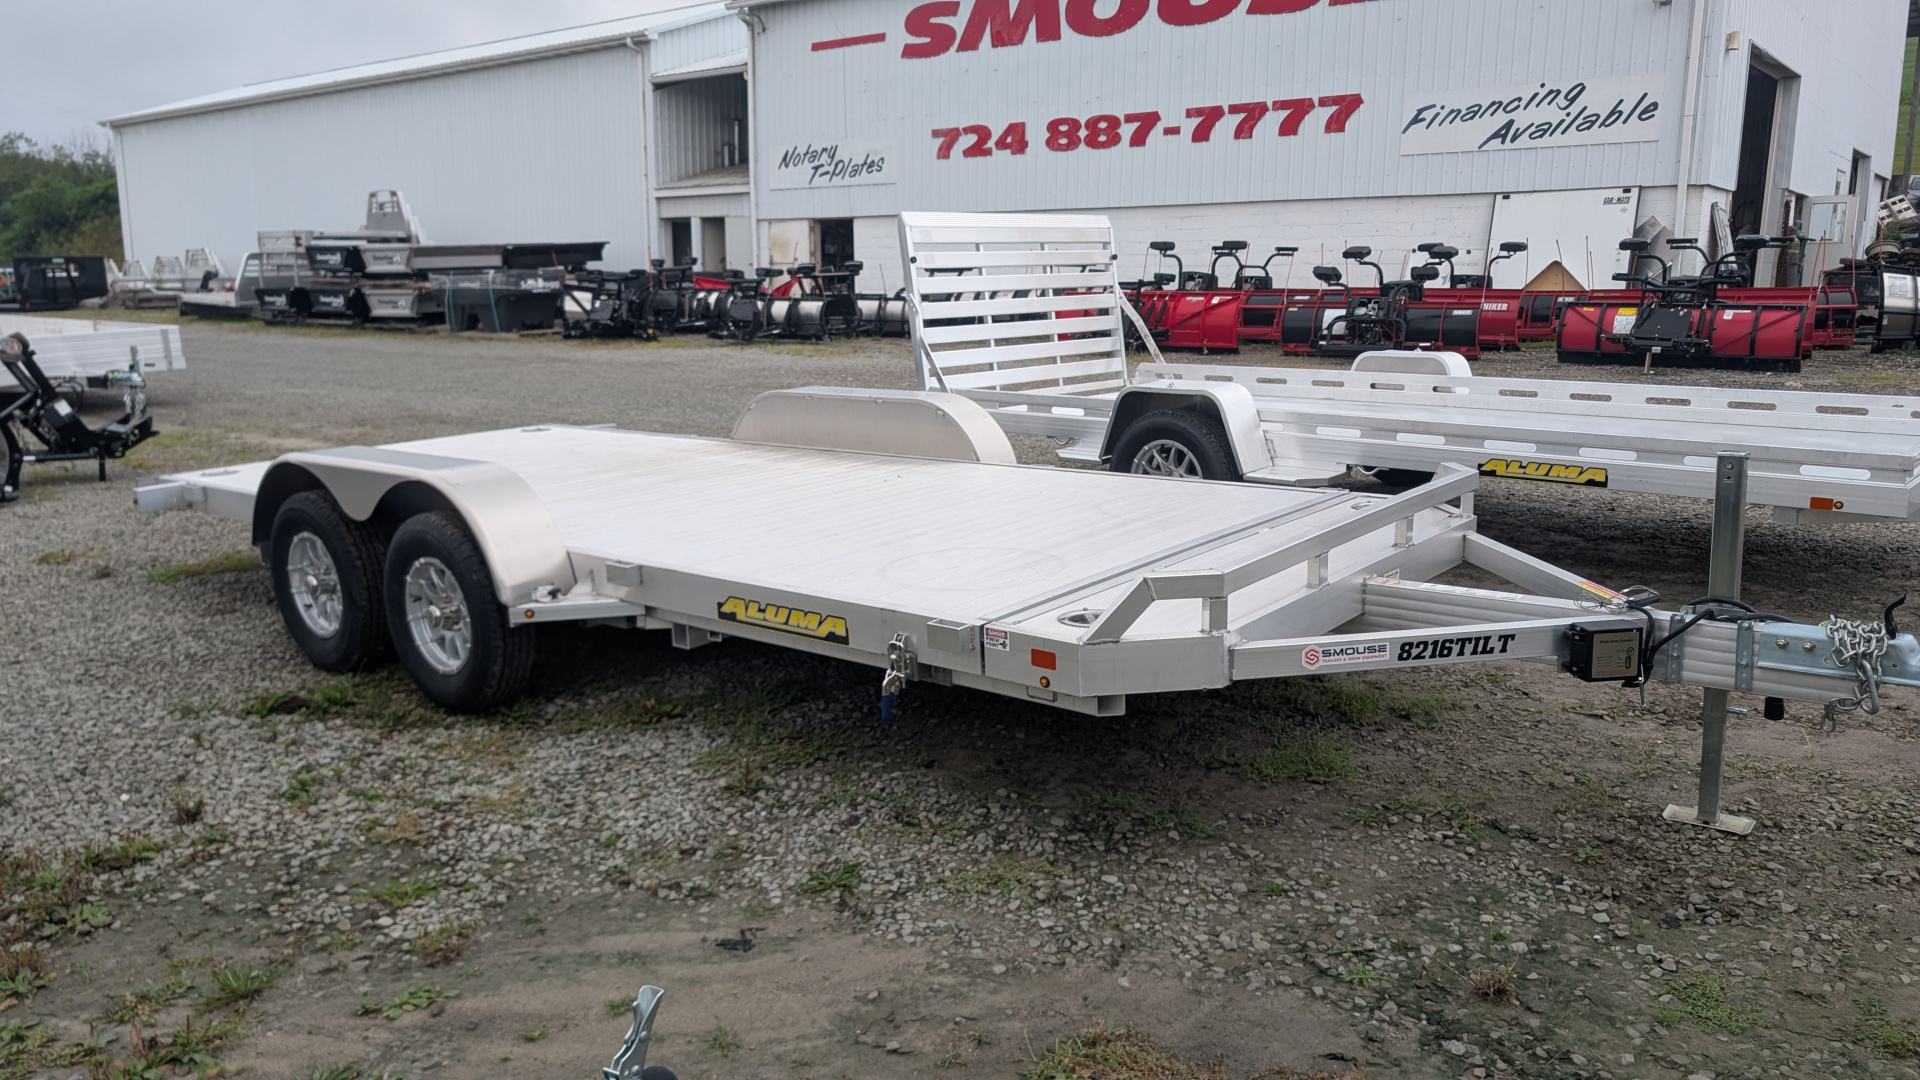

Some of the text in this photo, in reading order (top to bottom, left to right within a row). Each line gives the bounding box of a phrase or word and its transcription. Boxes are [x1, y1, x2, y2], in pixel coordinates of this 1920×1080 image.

[901, 0, 1379, 59] SMO
[931, 93, 1364, 160] 724 887-7777
[1401, 82, 1587, 135] Financing
[1477, 92, 1660, 150] Available
[778, 143, 839, 170] Notary
[808, 153, 885, 186] T-Plates
[1479, 459, 1608, 485] ALUMA
[719, 597, 848, 639] ALUMA
[1321, 644, 1387, 657] SMOUSE
[1397, 633, 1516, 661] 8216TILT
